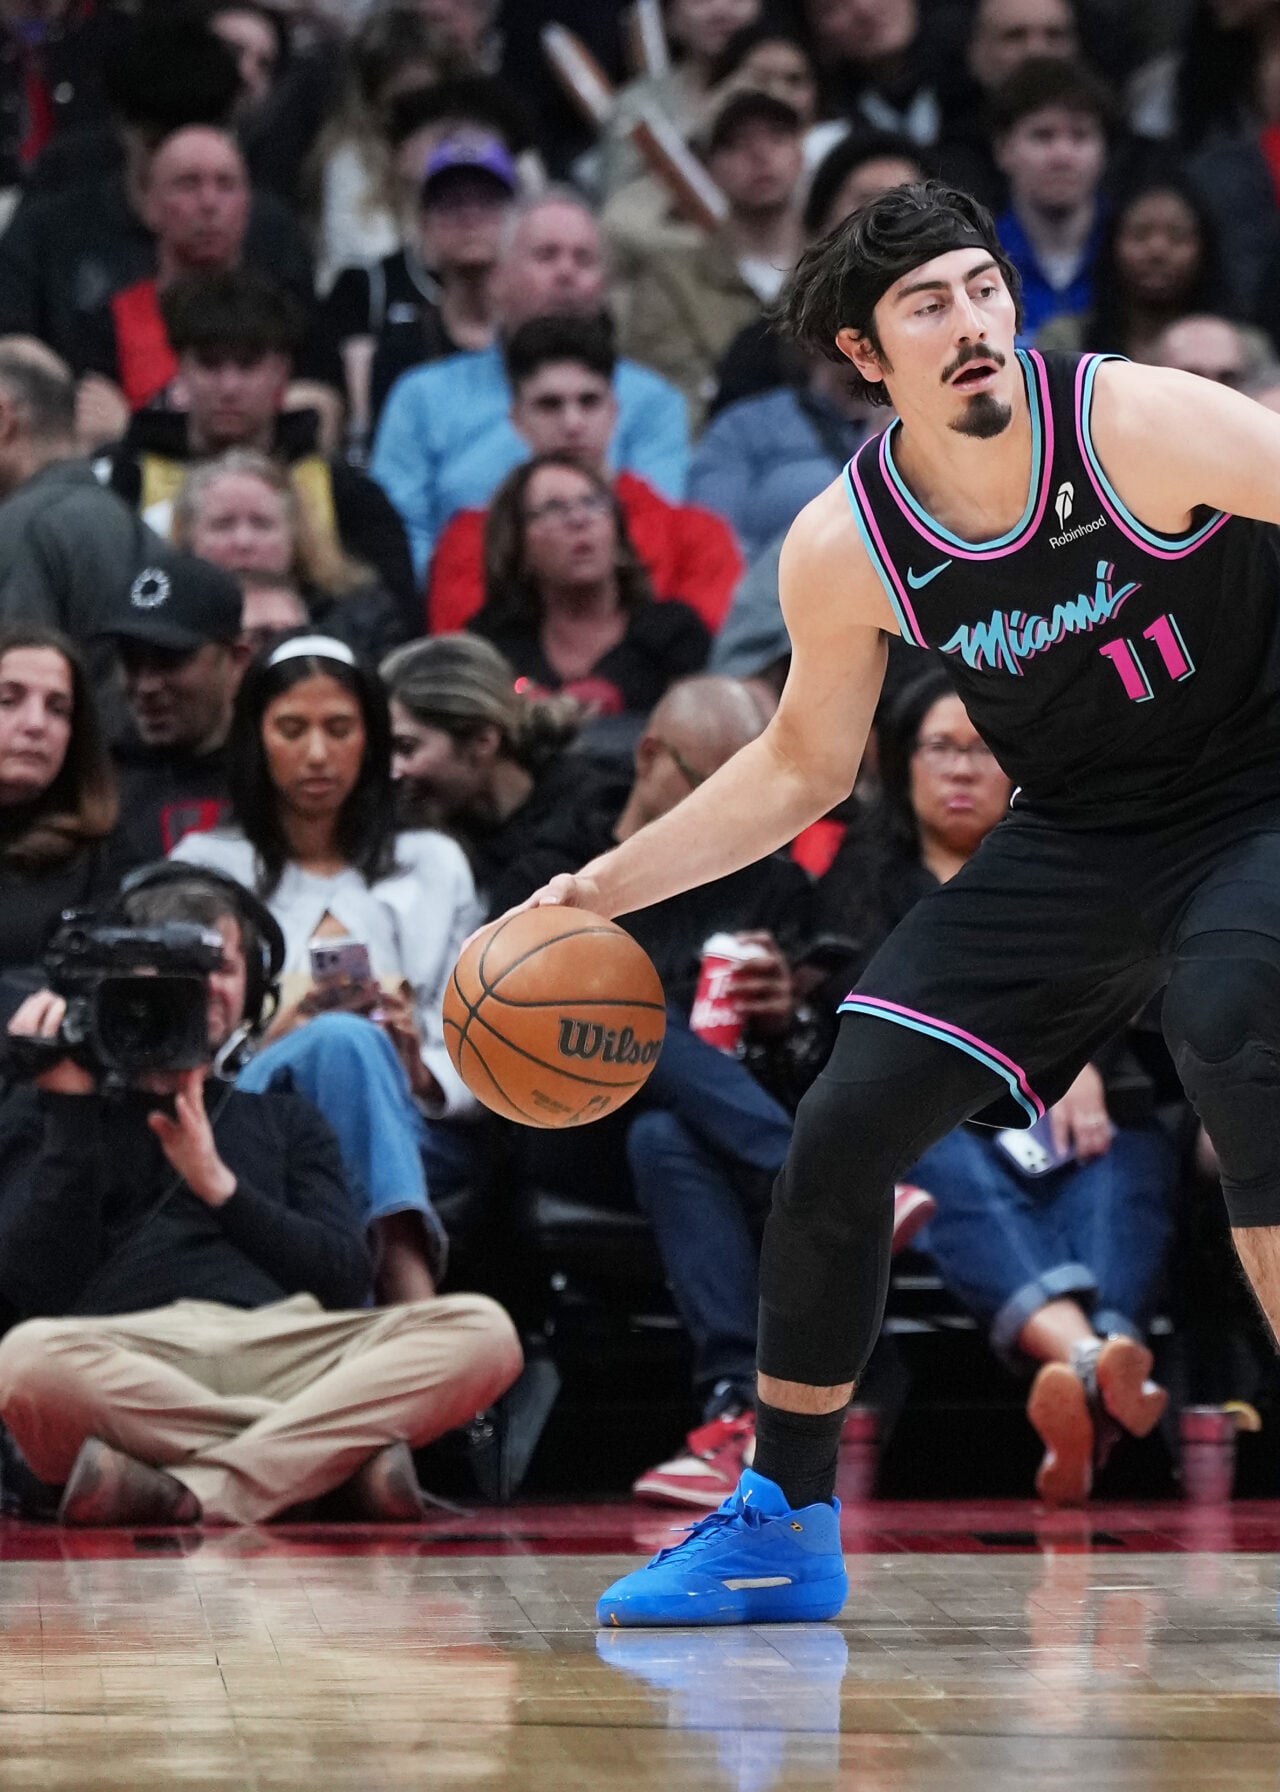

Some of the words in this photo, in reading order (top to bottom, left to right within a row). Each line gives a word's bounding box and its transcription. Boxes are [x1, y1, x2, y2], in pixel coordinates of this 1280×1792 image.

[1049, 514, 1107, 549] Robinhood
[938, 560, 1142, 676] Miami
[1099, 614, 1195, 703] 11
